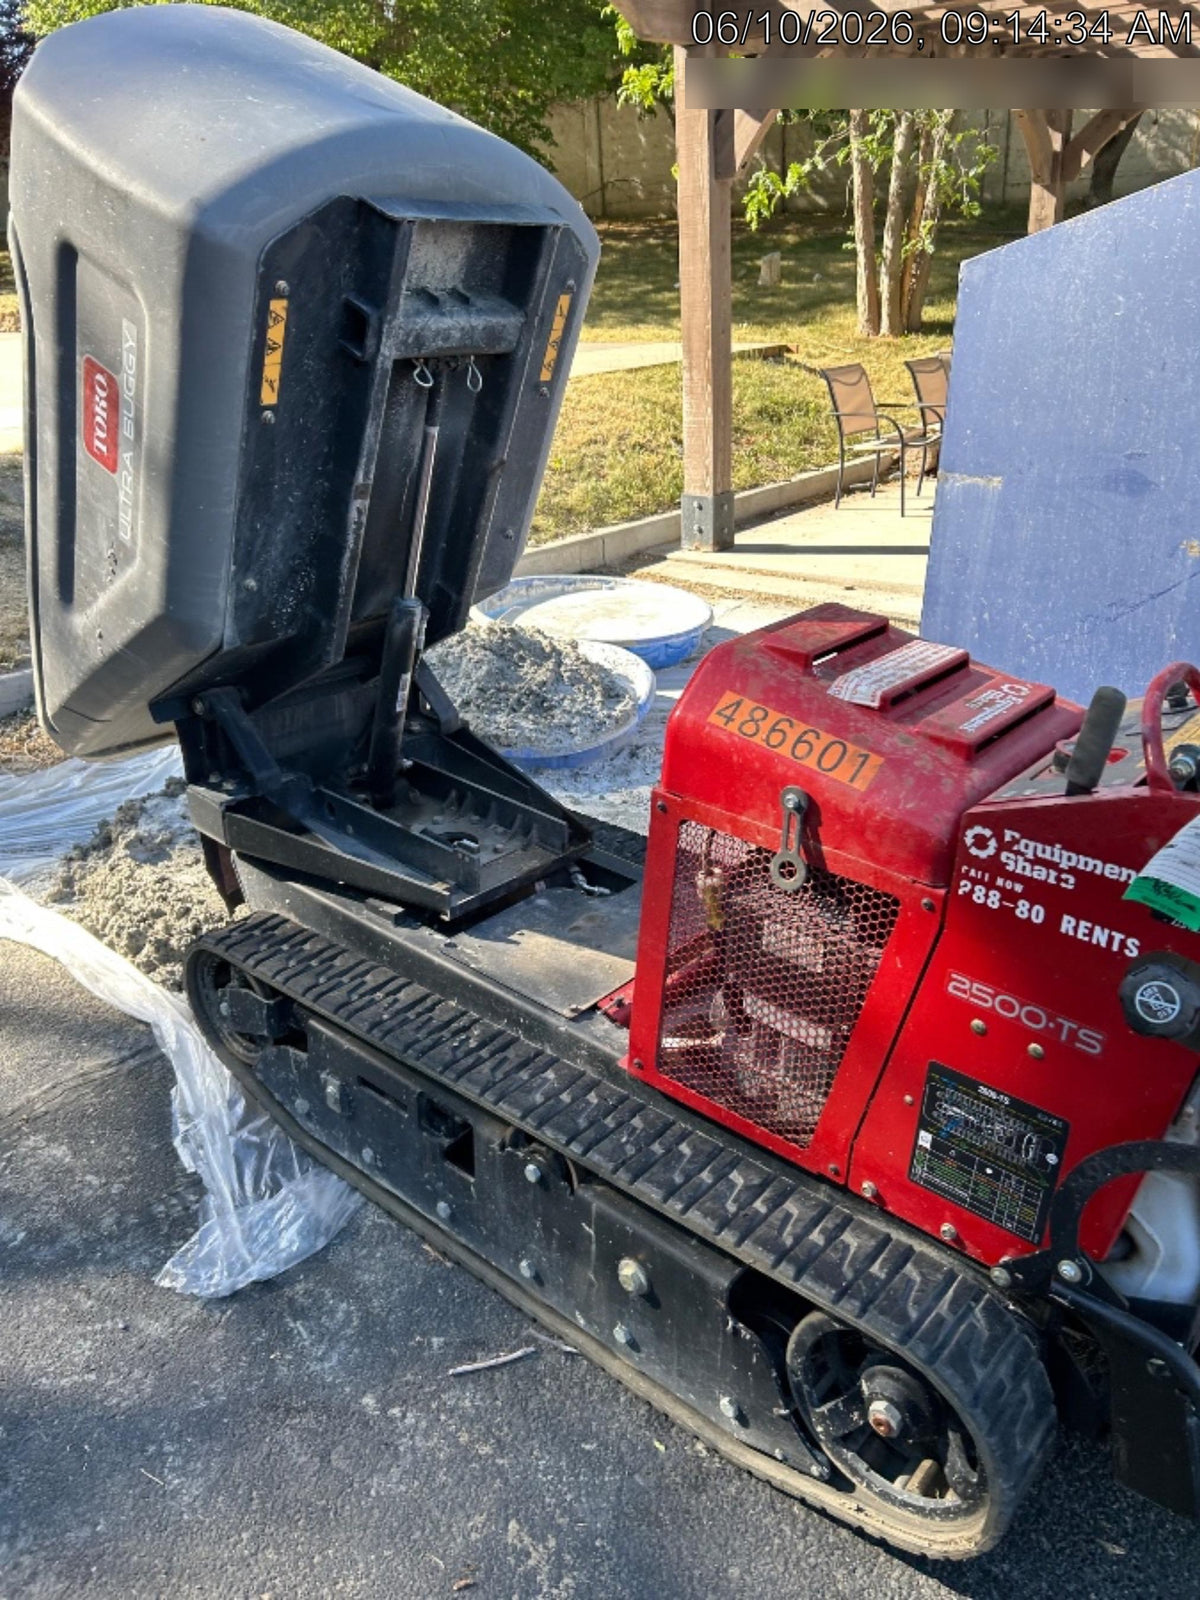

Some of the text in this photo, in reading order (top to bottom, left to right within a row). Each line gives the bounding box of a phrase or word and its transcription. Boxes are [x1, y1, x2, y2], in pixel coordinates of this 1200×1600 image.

[92, 373, 109, 455] TORO
[120, 327, 138, 541] ULTRA BUGGY
[713, 697, 872, 784] 486601
[995, 875, 1025, 894] NOW
[1003, 828, 1139, 884] Equipmen
[1059, 913, 1141, 957] RENTS
